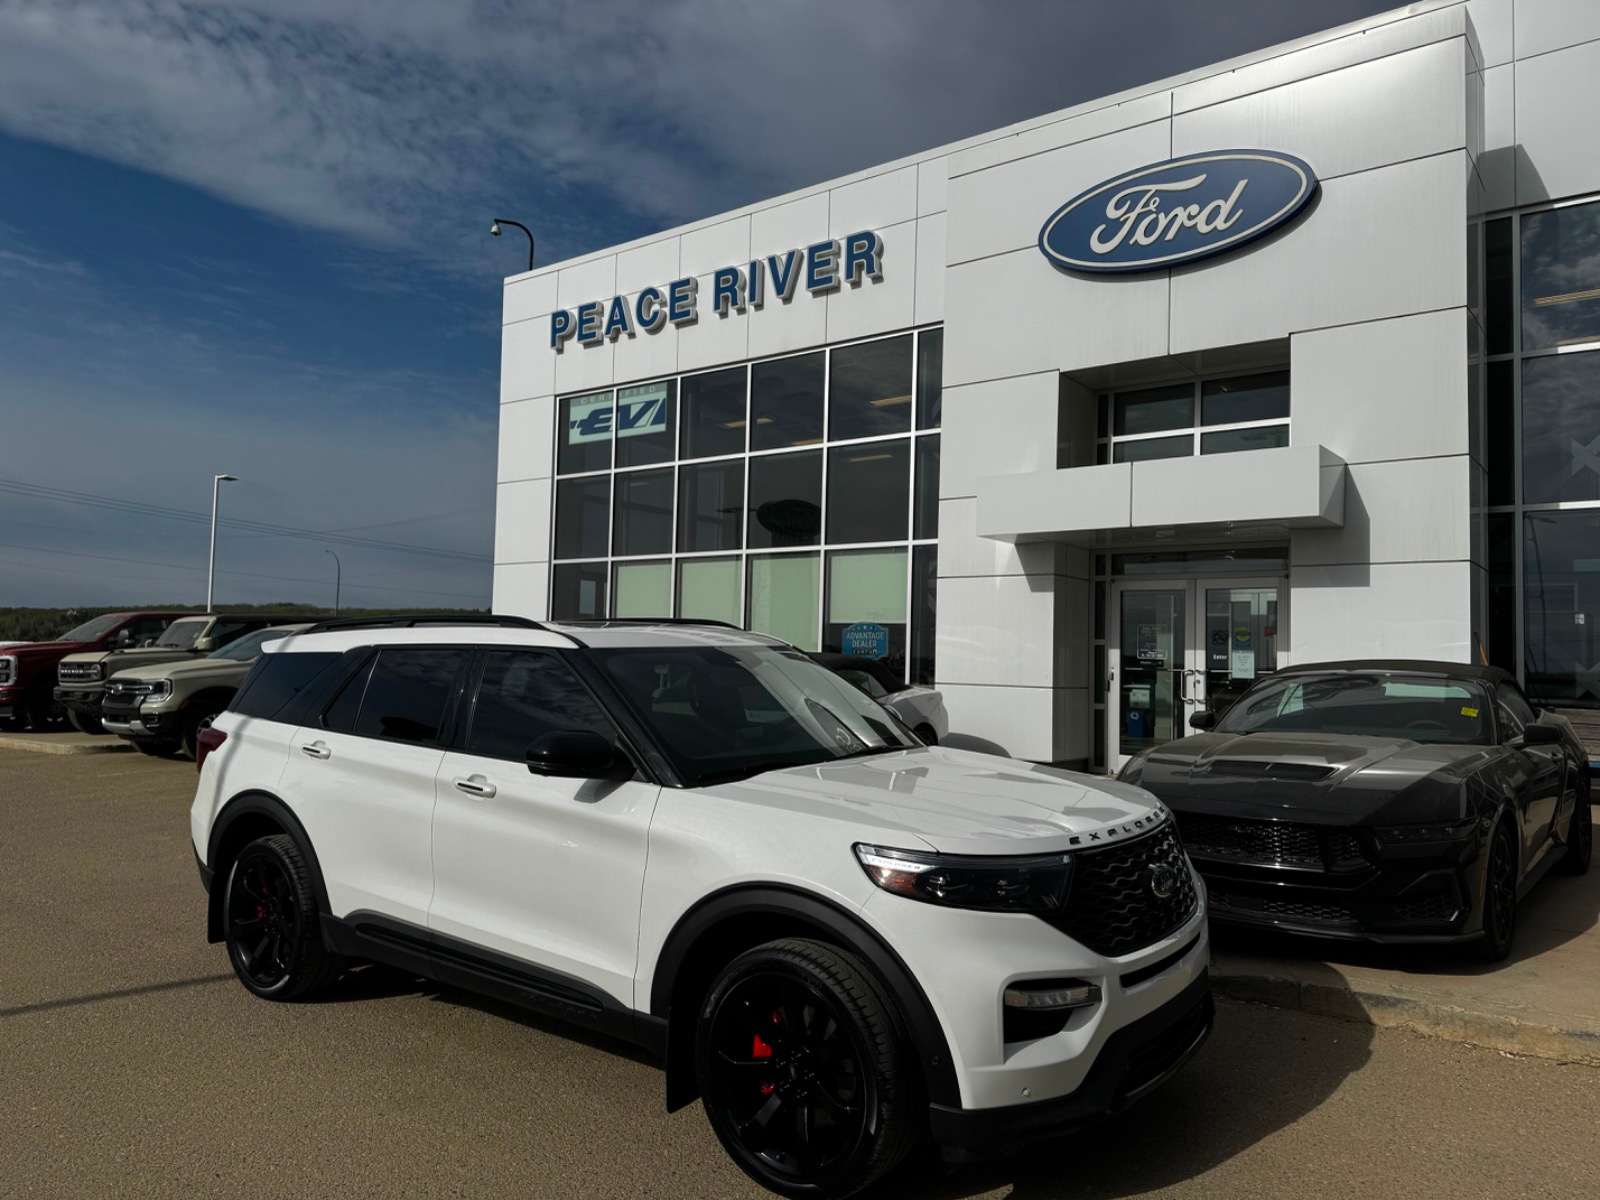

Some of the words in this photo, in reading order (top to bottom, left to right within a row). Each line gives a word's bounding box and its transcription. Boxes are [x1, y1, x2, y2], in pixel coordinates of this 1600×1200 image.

[1090, 174, 1248, 254] Ford
[550, 276, 697, 351] PEACE
[713, 230, 883, 317] RIVER
[847, 631, 885, 640] ADVANTAGE
[851, 640, 877, 648] DEALER
[1068, 806, 1166, 846] EXPLORER
